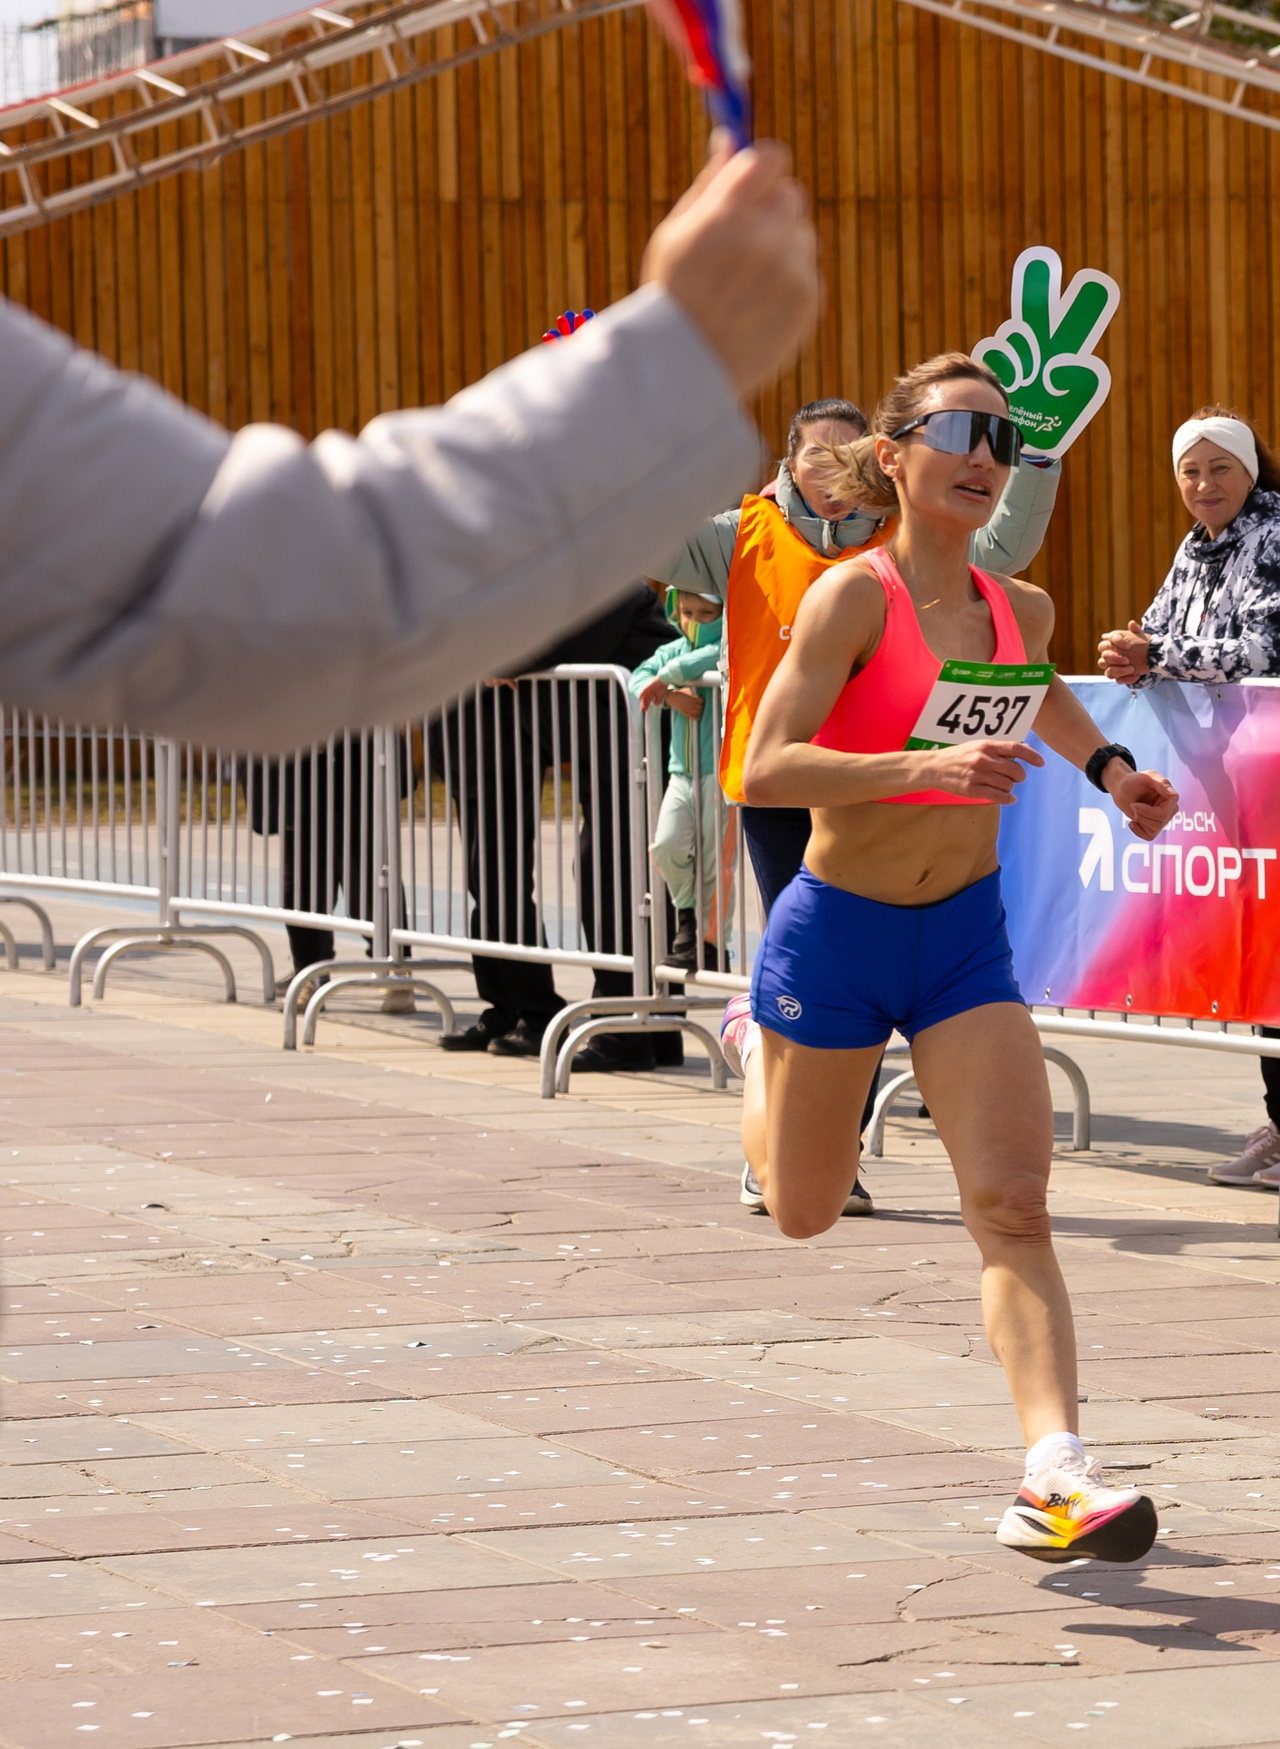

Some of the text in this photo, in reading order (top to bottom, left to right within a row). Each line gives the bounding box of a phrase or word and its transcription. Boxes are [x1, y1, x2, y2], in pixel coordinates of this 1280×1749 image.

[1009, 405, 1043, 421] елёный
[1009, 414, 1037, 428] рафон
[936, 694, 1031, 736] 4537
[1122, 811, 1217, 833] НРЬСК
[1121, 843, 1277, 900] СПОРТ
